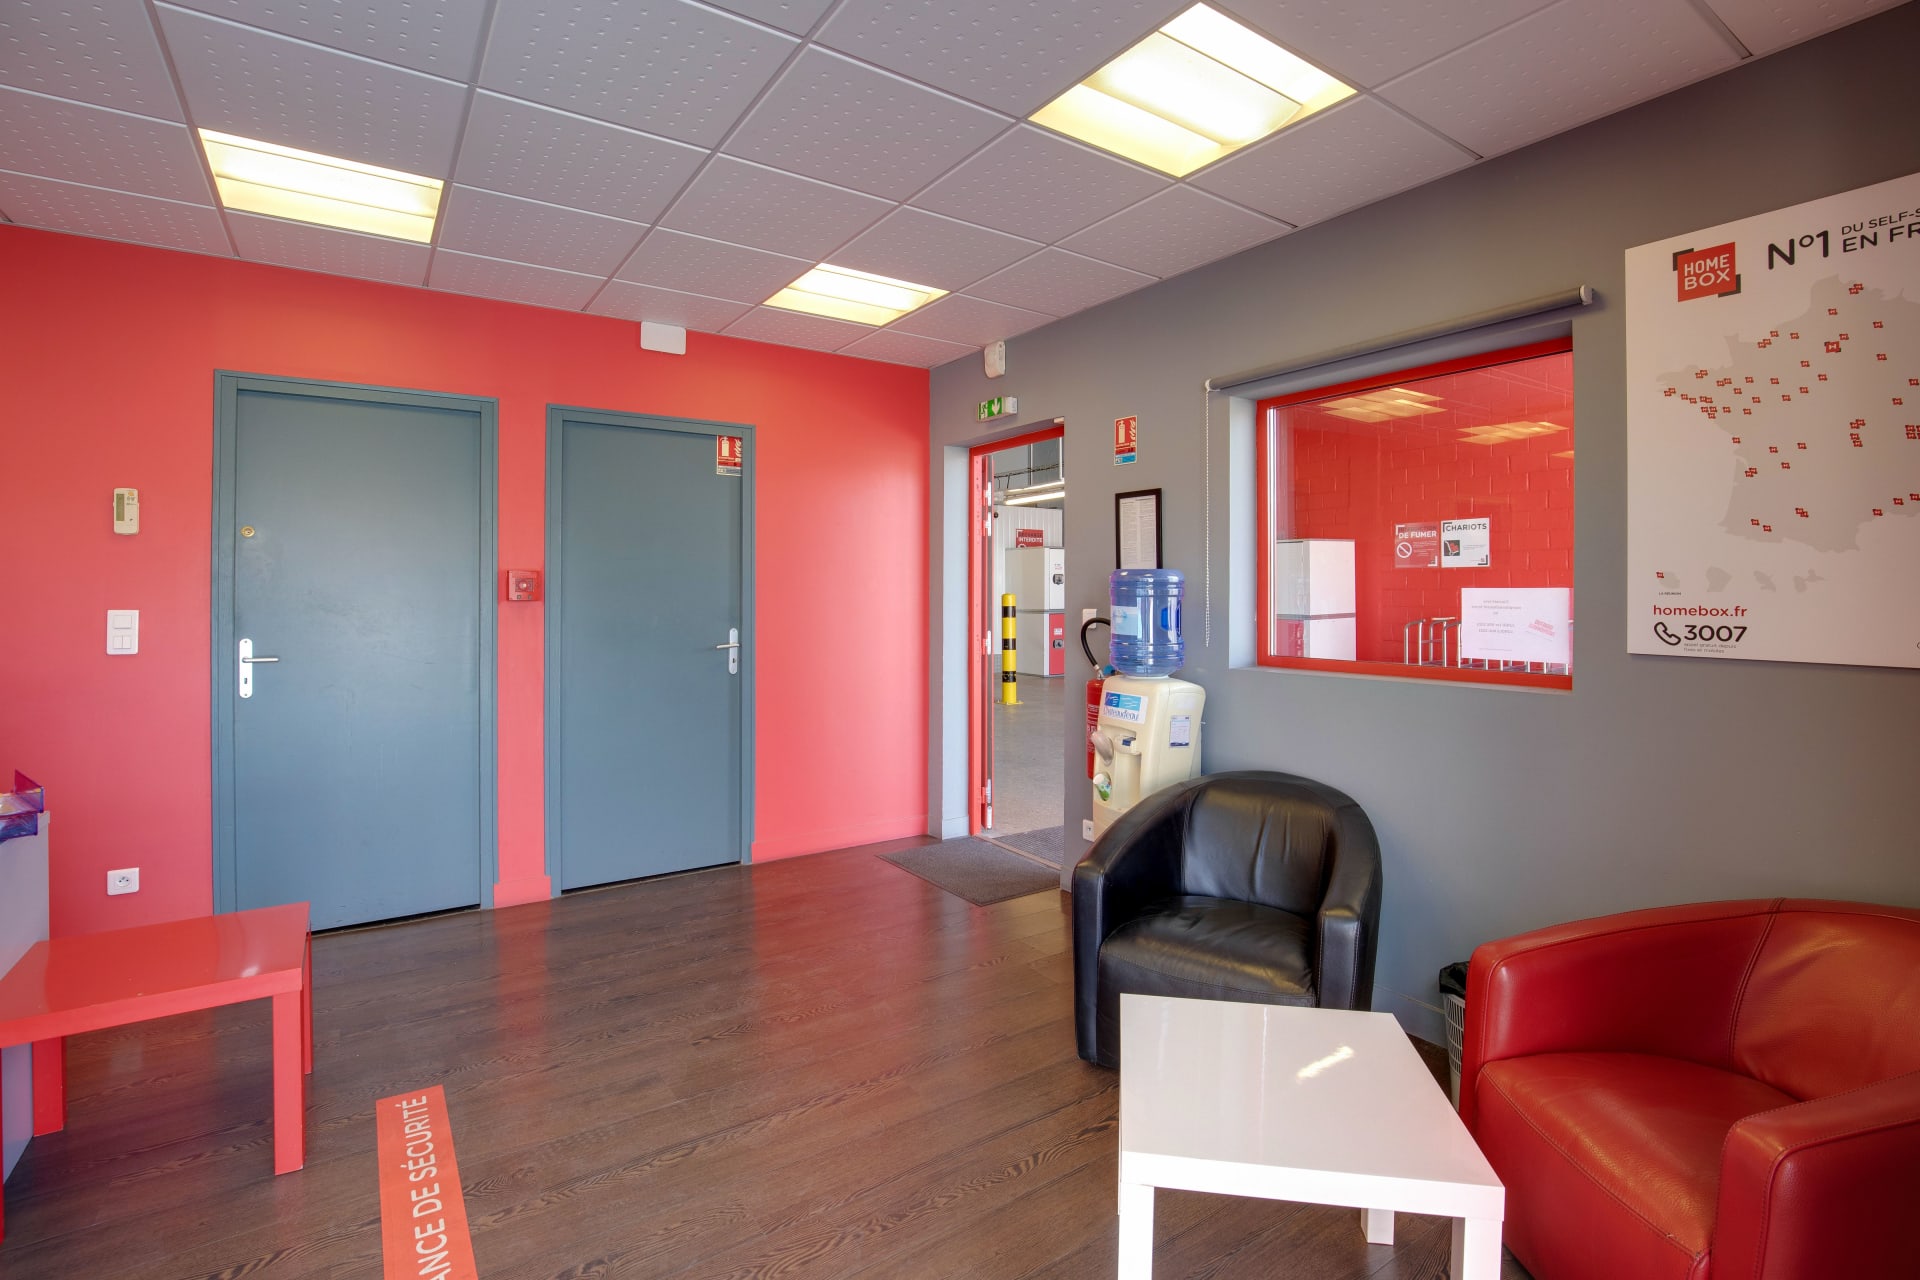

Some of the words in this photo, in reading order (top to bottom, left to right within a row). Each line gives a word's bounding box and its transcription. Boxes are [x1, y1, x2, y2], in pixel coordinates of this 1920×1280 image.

[1841, 222, 1864, 236] DU
[1842, 231, 1878, 253] EN
[1889, 221, 1920, 243] FR
[1684, 253, 1730, 277] HOME
[1684, 267, 1730, 291] BOX
[1410, 530, 1437, 538] FUMER
[1445, 523, 1488, 532] CHARIOTS
[1653, 605, 1747, 617] homebox.fr
[1684, 625, 1748, 642] 3007
[395, 1095, 440, 1182] SÉCURITÉ
[411, 1182, 443, 1218] DE
